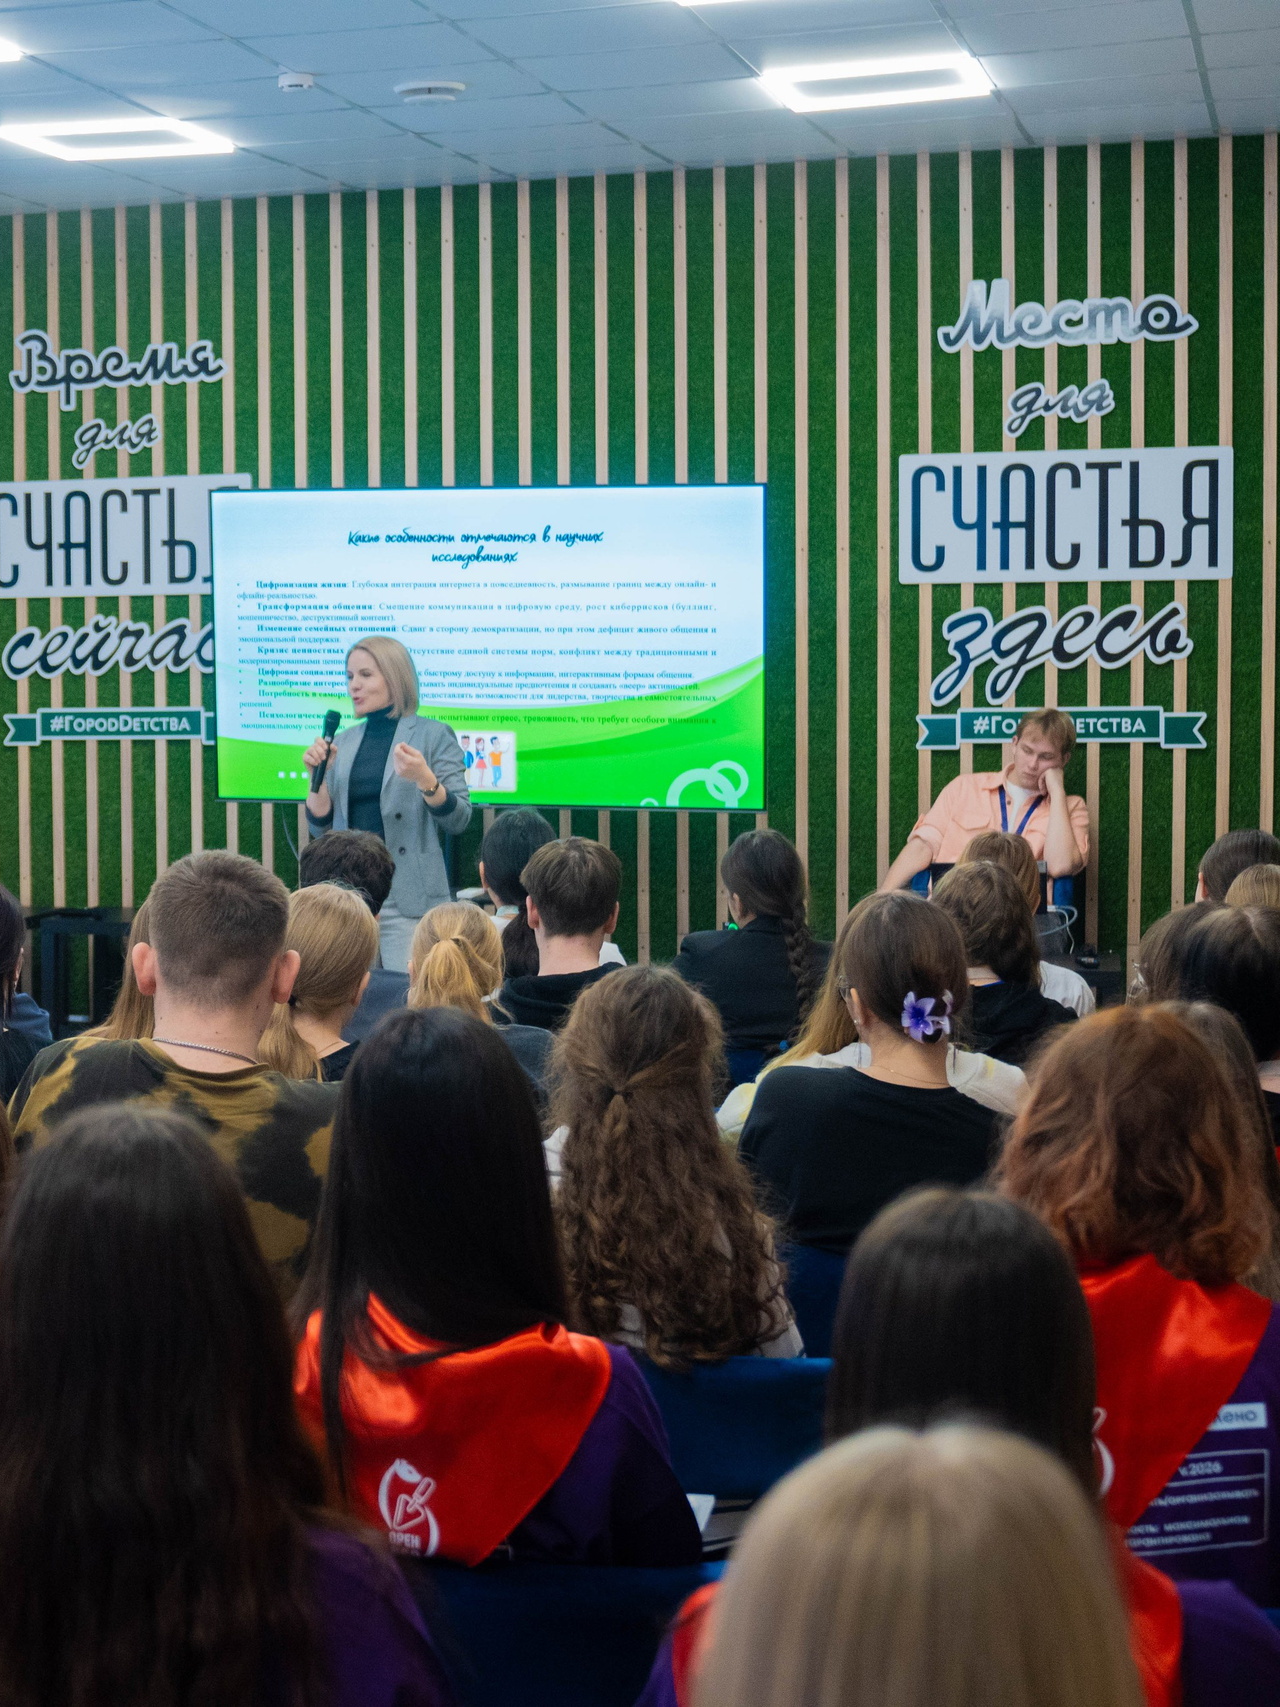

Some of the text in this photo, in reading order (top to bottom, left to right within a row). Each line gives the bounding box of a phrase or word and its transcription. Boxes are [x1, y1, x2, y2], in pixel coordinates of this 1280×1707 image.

[942, 282, 1194, 347] Место
[14, 334, 223, 405] Время
[1007, 381, 1113, 434] для
[75, 418, 158, 465] для
[348, 525, 604, 547] Какие особенности отмечаются в научных
[911, 459, 1219, 572] СЧАСТЬЯ
[431, 545, 518, 569] исследованиях
[7, 621, 214, 675] сейчас
[934, 606, 1188, 700] здесь
